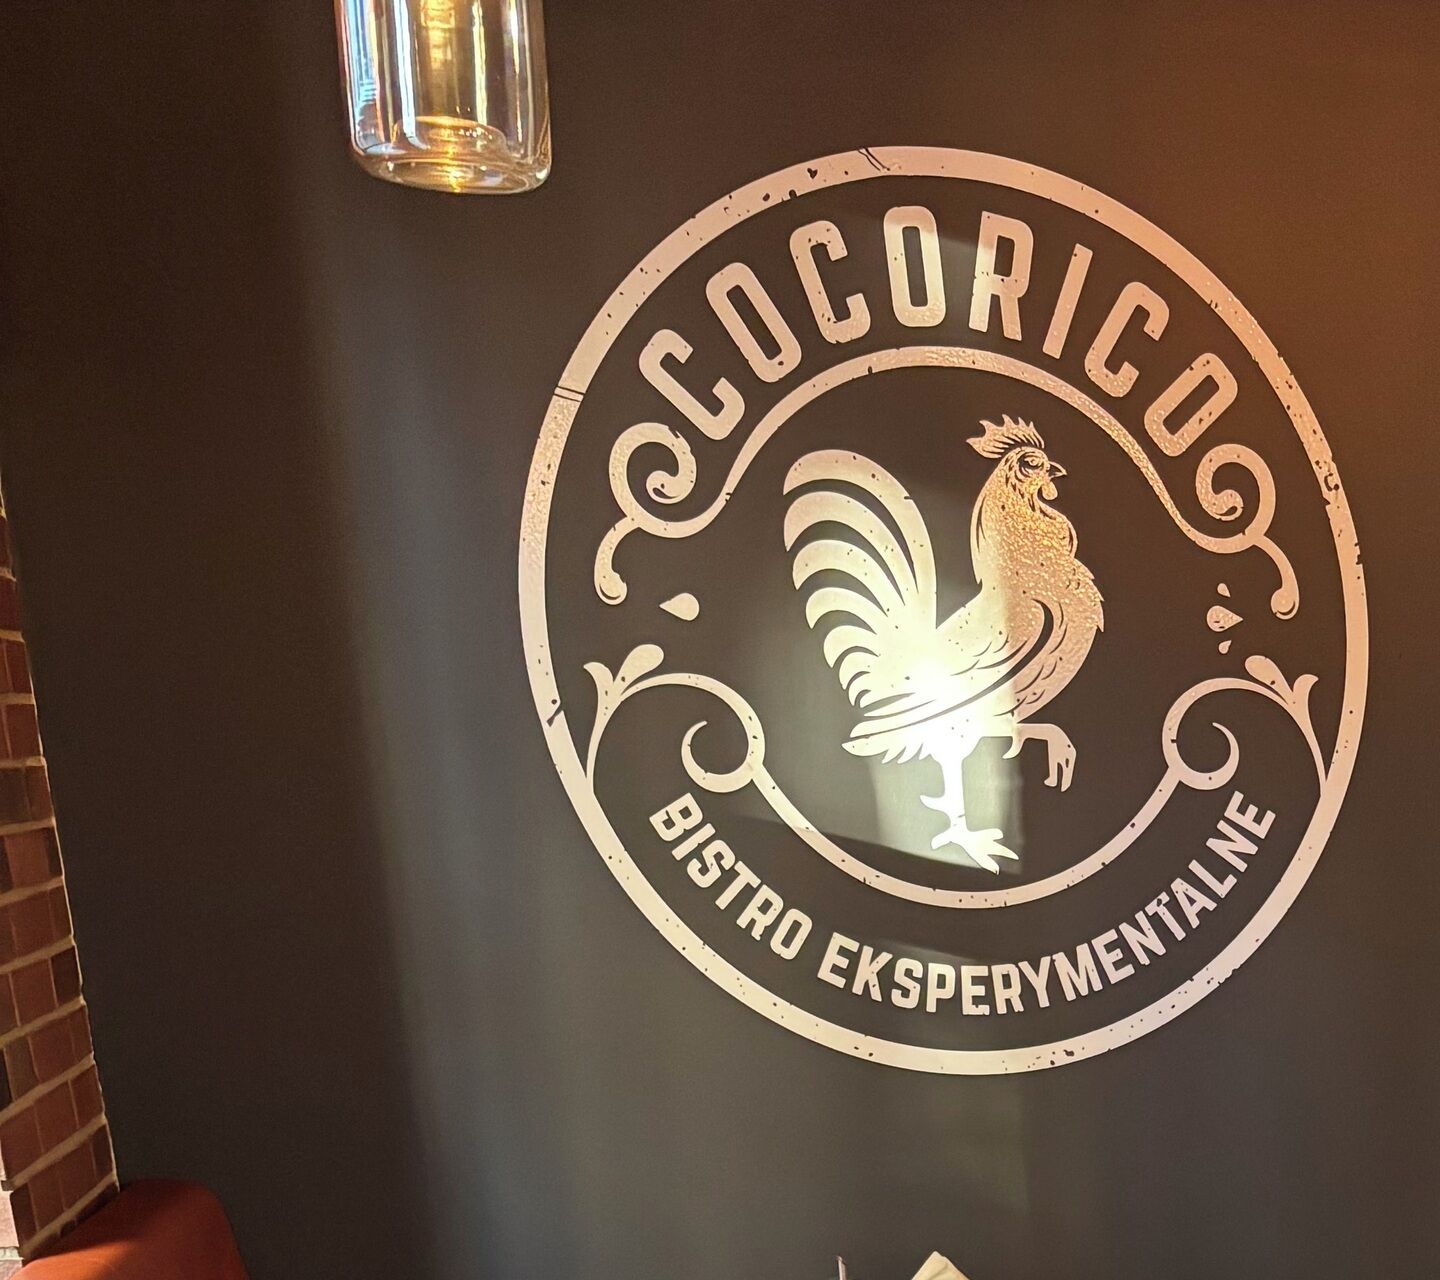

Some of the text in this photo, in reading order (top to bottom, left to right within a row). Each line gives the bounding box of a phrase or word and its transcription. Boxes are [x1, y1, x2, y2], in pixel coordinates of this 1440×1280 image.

[639, 206, 1239, 457] COCORICO
[649, 791, 1277, 1016] BISTRO EKSPERYMENTALNE
